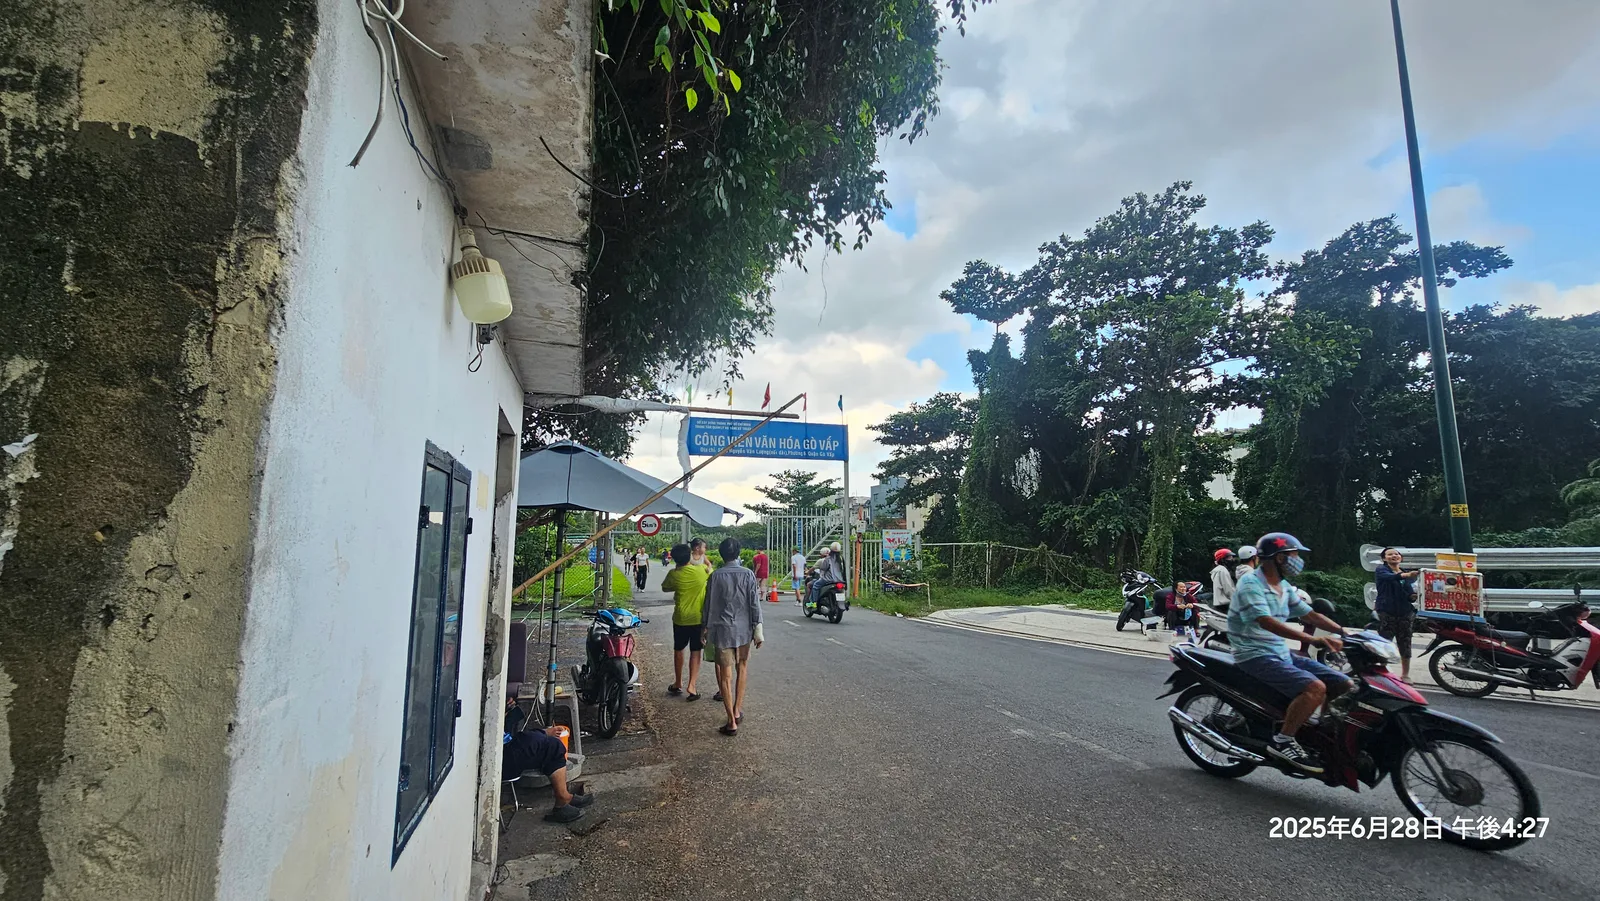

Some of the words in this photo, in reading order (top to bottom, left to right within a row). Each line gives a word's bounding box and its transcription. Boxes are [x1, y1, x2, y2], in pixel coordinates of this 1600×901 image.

[694, 432, 725, 446] CÔNG
[727, 434, 753, 448] VIÊN
[754, 434, 776, 449] VĂN
[779, 436, 801, 450] HÓA
[803, 436, 817, 450] GÒ
[819, 435, 840, 451] VẤP
